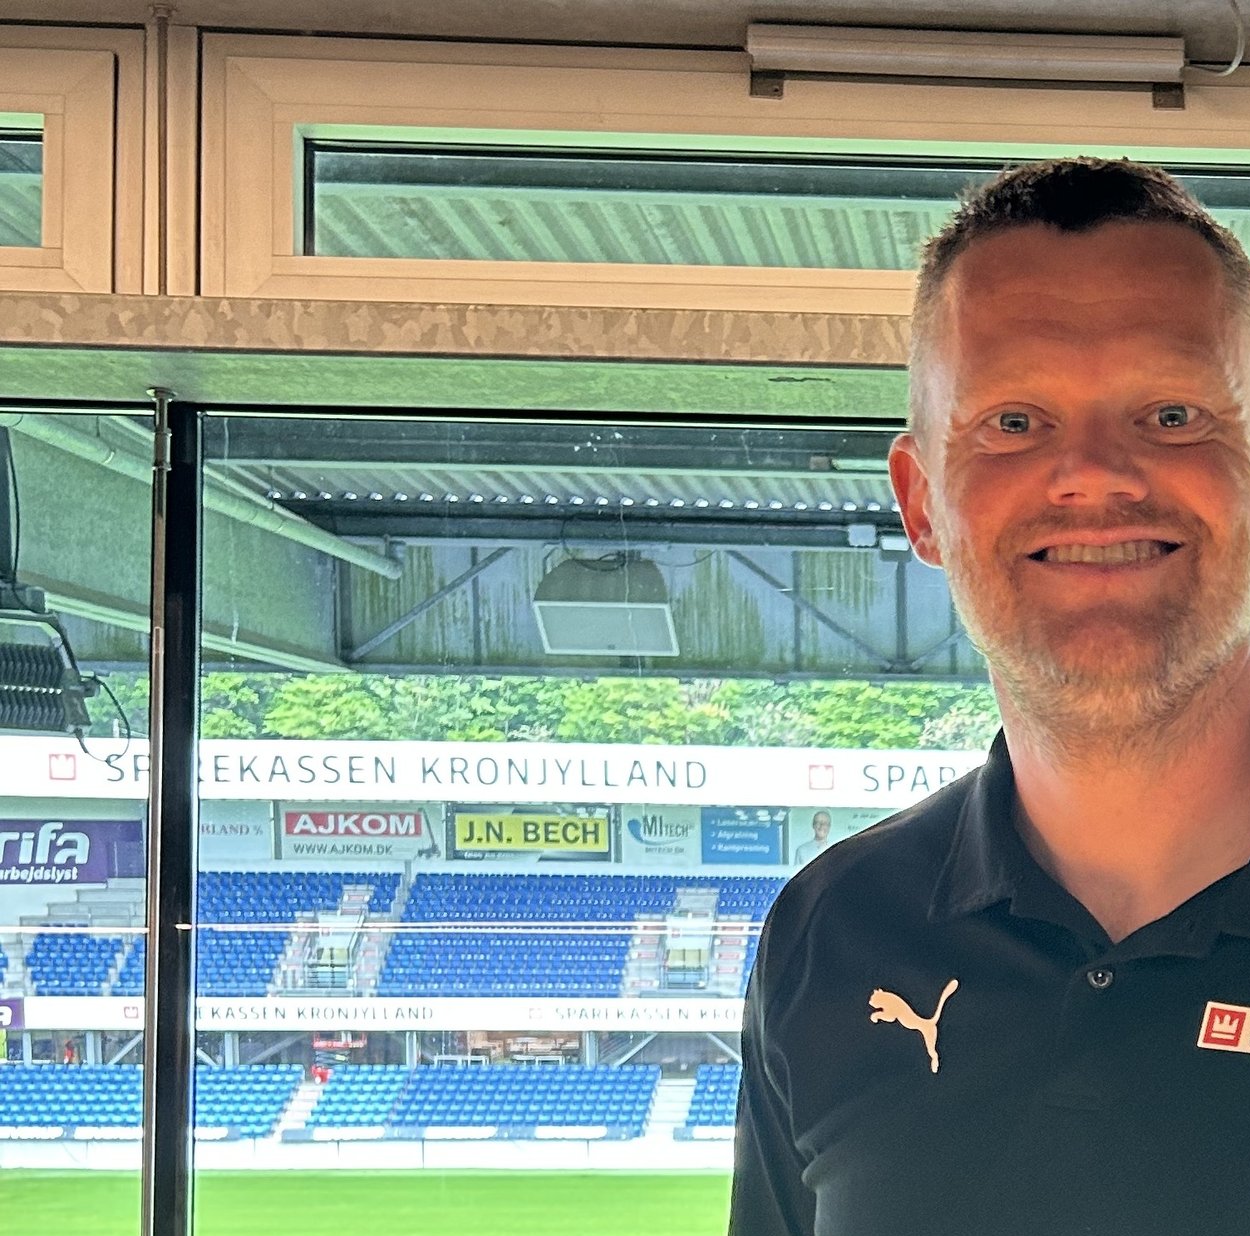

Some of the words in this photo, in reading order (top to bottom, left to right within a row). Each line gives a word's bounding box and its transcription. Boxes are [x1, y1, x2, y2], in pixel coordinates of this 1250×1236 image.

[106, 753, 396, 784] SPEKASSEN
[421, 756, 707, 789] KRONJYLLAND
[862, 764, 973, 793] SPAR
[293, 814, 416, 835] AJKOM
[463, 820, 512, 844] J.N.
[523, 820, 600, 845] BECH
[0, 822, 90, 865] rifa
[293, 843, 393, 856] WWW.AJKOM.DK
